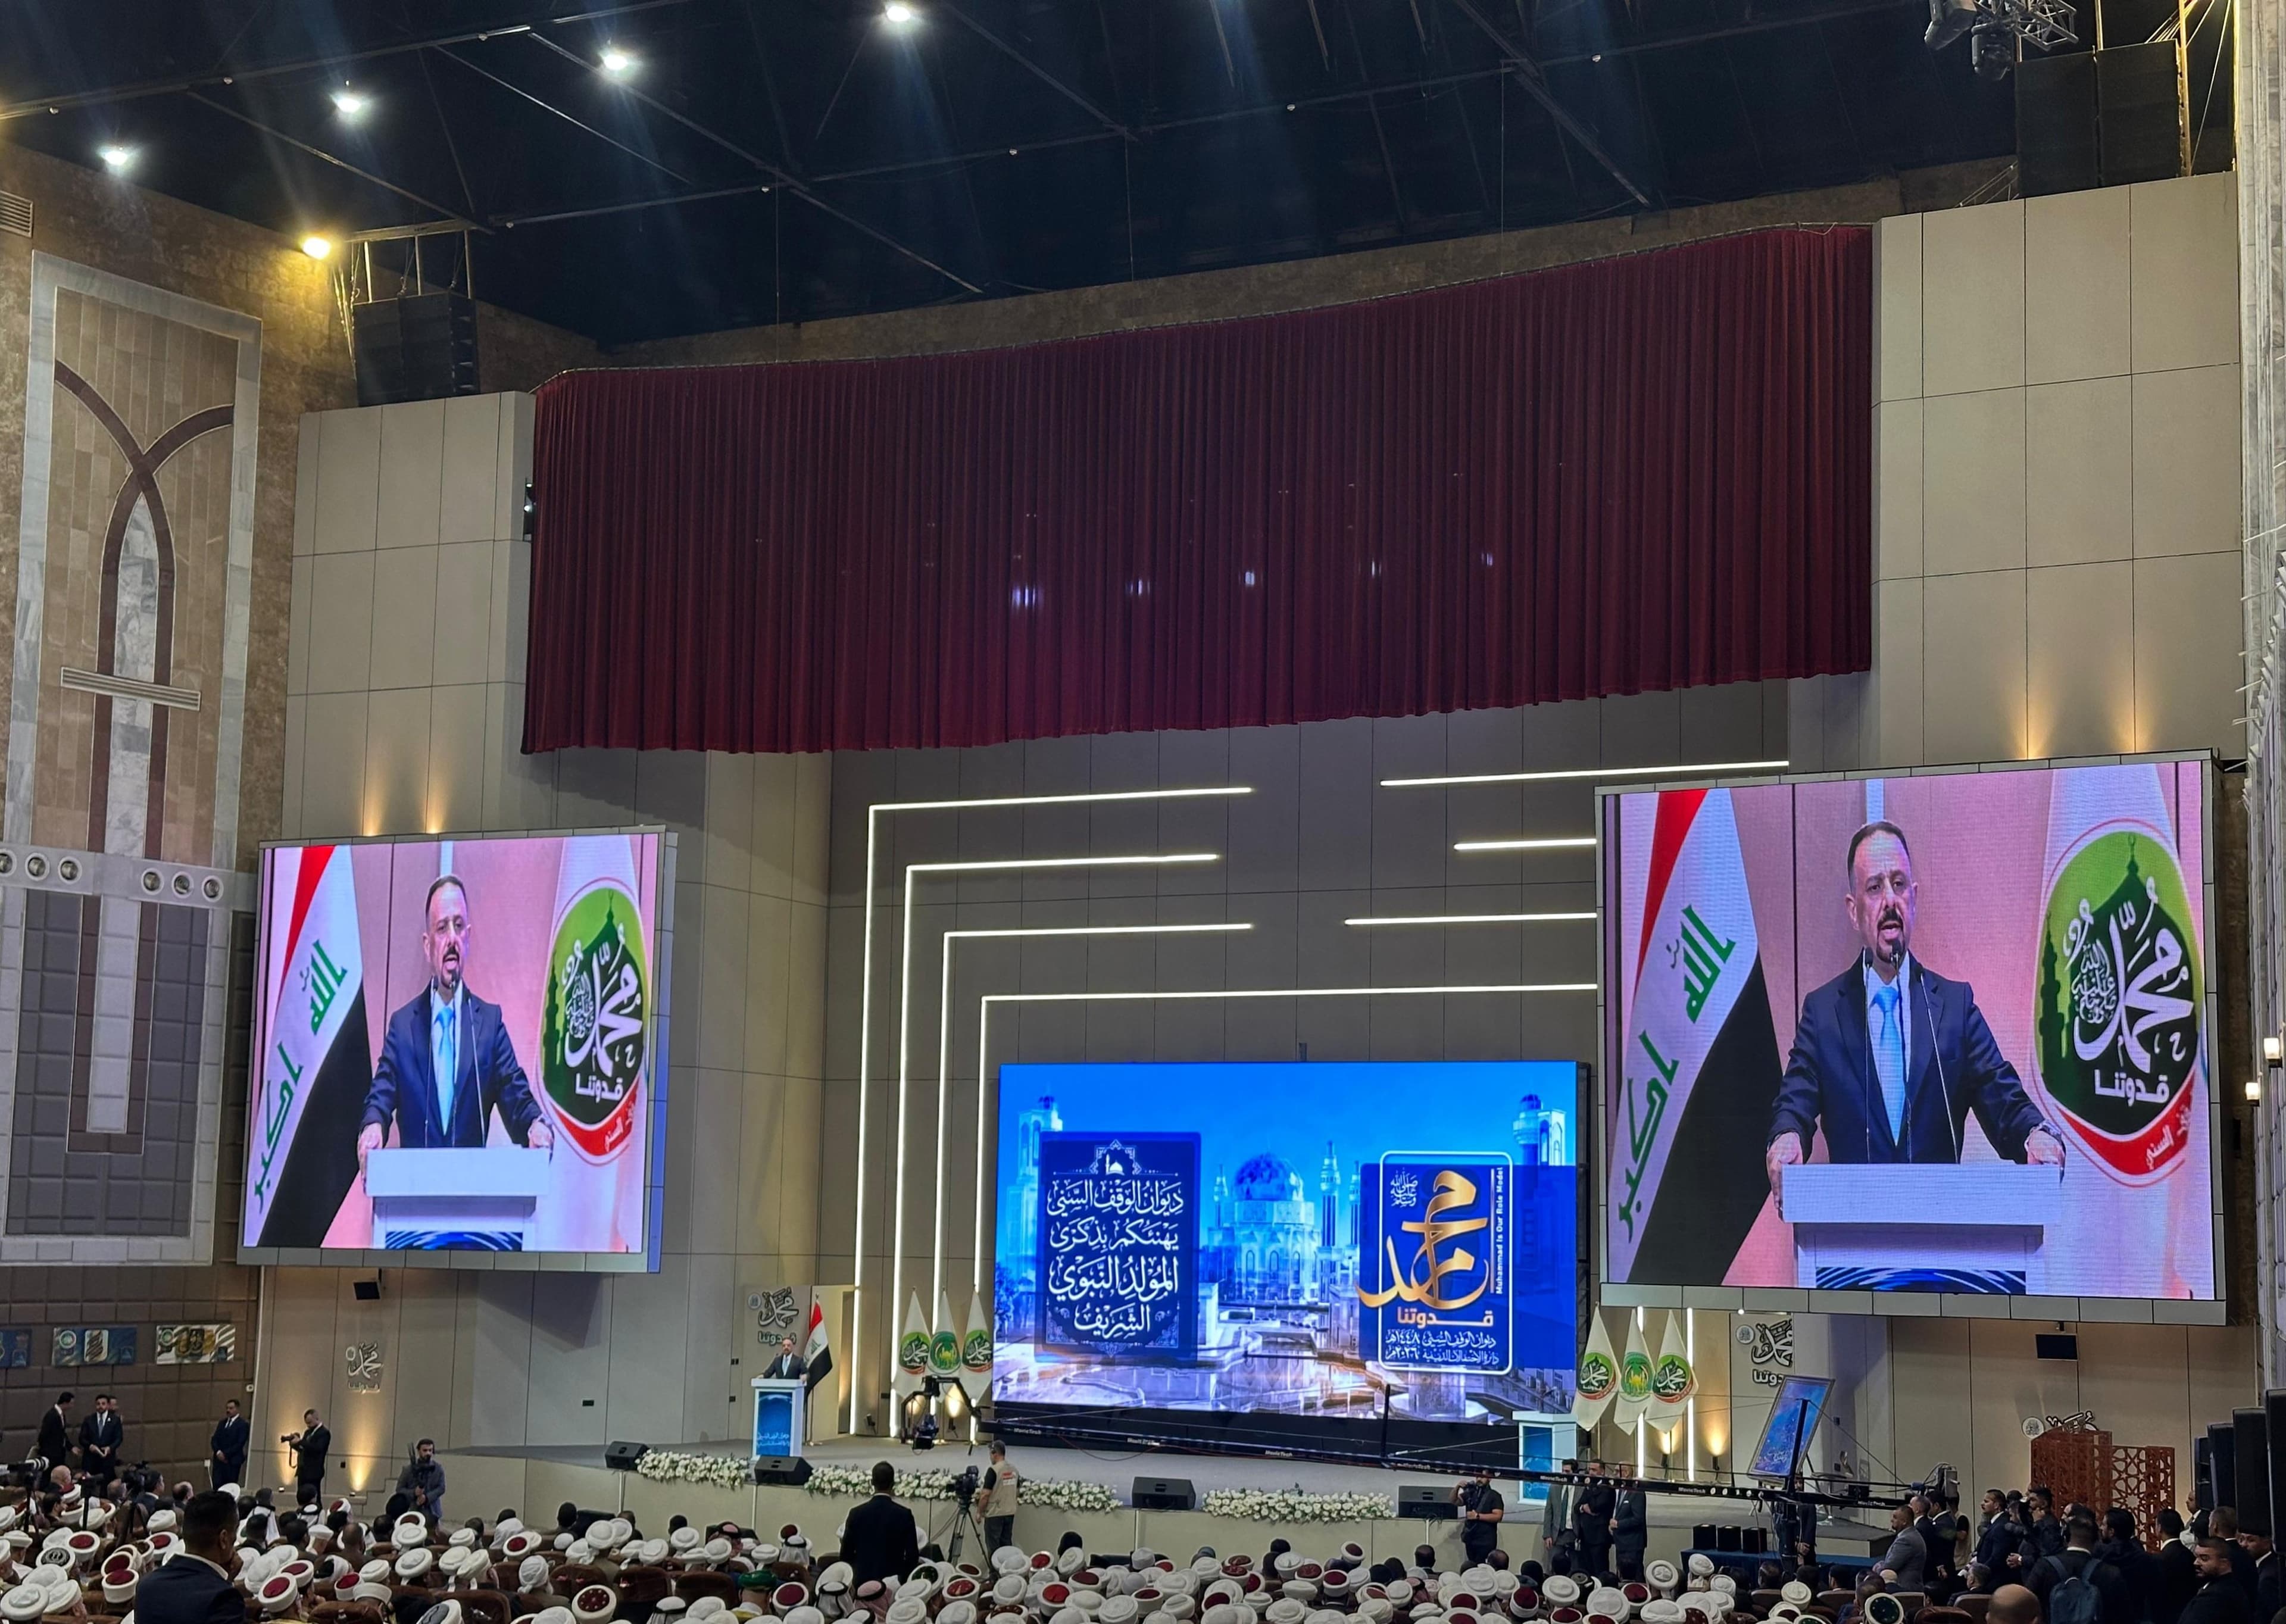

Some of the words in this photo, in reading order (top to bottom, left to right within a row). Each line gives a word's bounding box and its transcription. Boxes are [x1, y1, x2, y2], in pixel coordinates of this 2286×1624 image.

[311, 939, 347, 1036] الله
[1679, 904, 1736, 1023] الله
[2072, 899, 2194, 1073] محمد
[564, 941, 643, 1077] محمد
[576, 1073, 623, 1103] قدوتنا
[2094, 1069, 2169, 1107] قدوتنا
[1355, 1170, 1488, 1310] محمد
[1495, 1234, 1503, 1242] Is
[1397, 1307, 1494, 1329] قدوتنا
[1753, 1369, 1785, 1387] دوتنا
